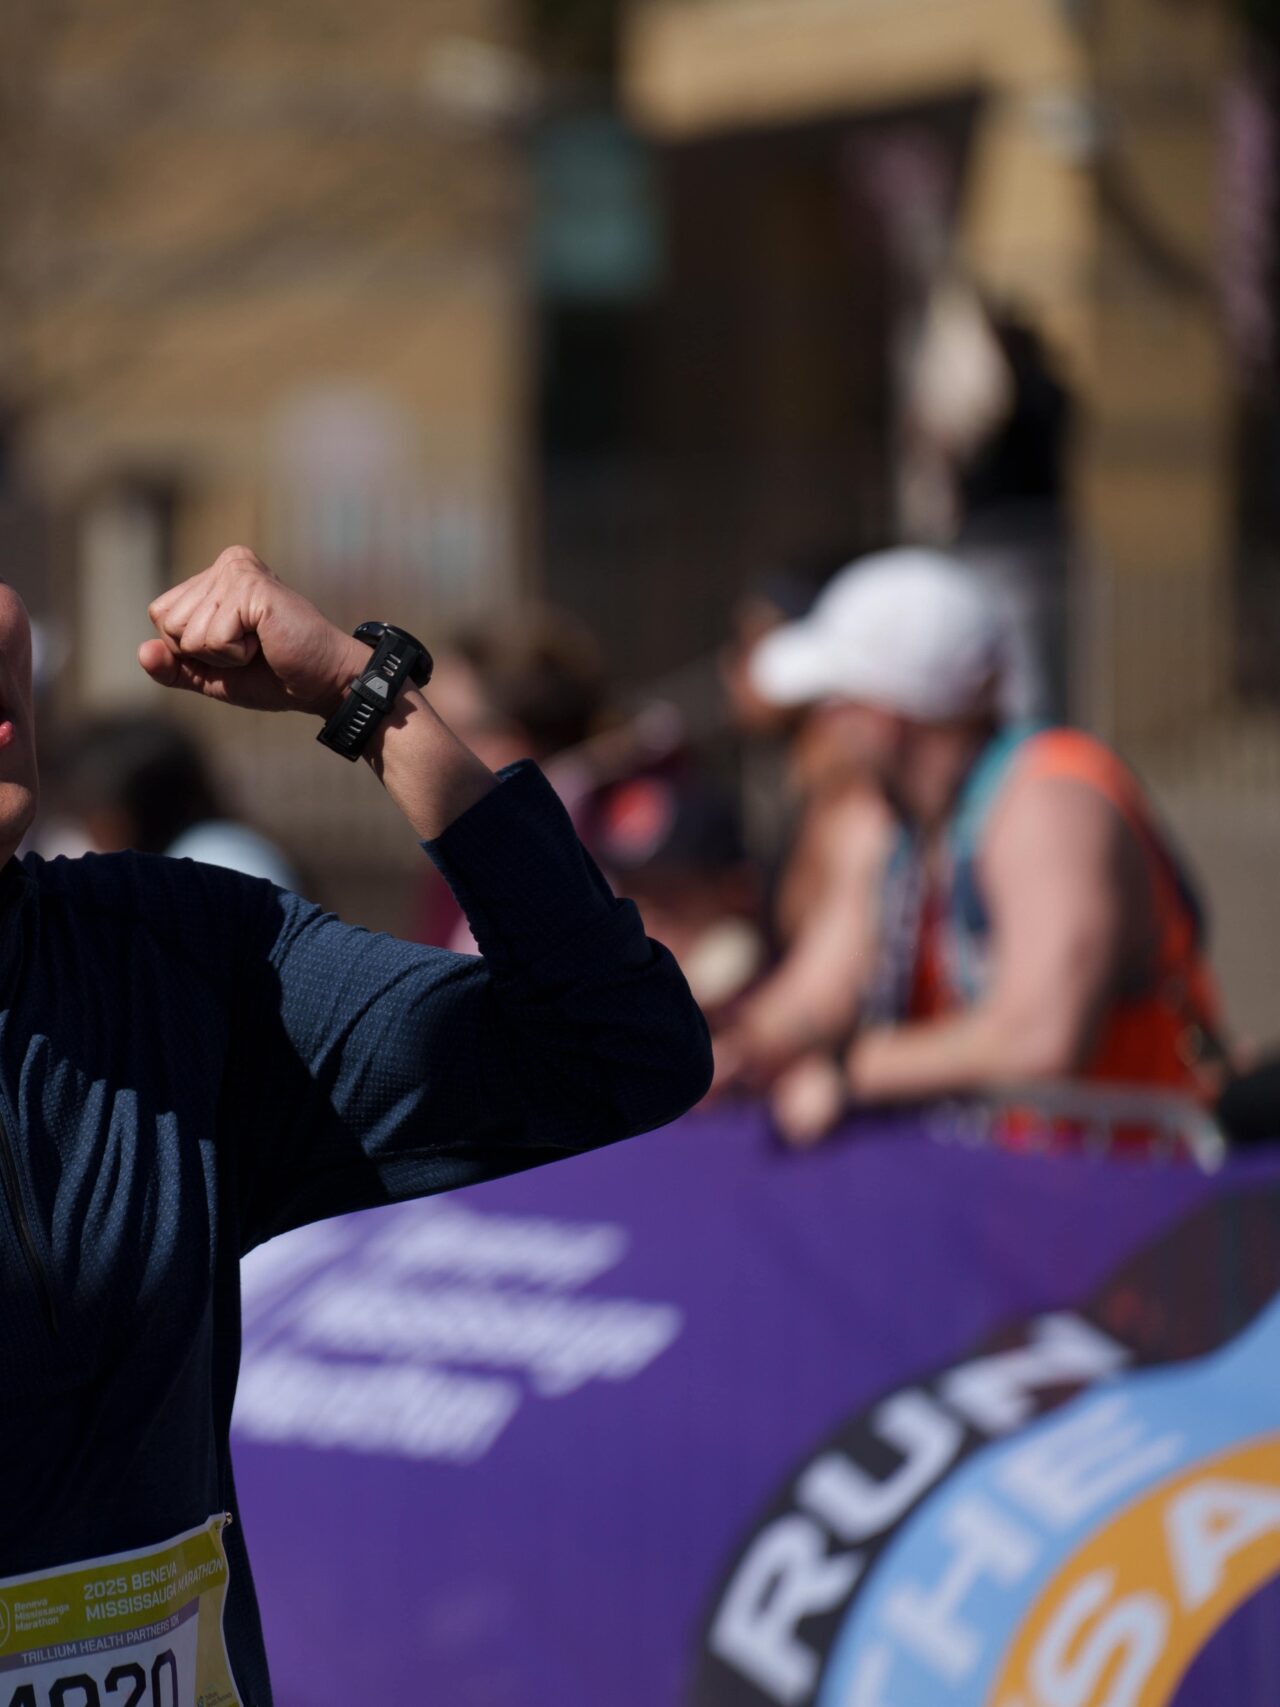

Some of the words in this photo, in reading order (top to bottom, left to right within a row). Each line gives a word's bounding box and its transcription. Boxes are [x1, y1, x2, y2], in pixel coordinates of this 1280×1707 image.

[710, 1309, 1130, 1704] RUN
[844, 1392, 1186, 1707] HE
[83, 1576, 128, 1601] 2025
[131, 1561, 177, 1590] BENEVA
[85, 1582, 177, 1622] MISSISSAUGA
[178, 1557, 223, 1592] MARATHON
[14, 1598, 48, 1611] Beneva
[15, 1603, 70, 1620] Mississauga
[15, 1616, 59, 1633] Marathon
[22, 1644, 76, 1665] TRILLIUM
[80, 1635, 123, 1654] HEALTH
[126, 1619, 169, 1644] PARTNERS
